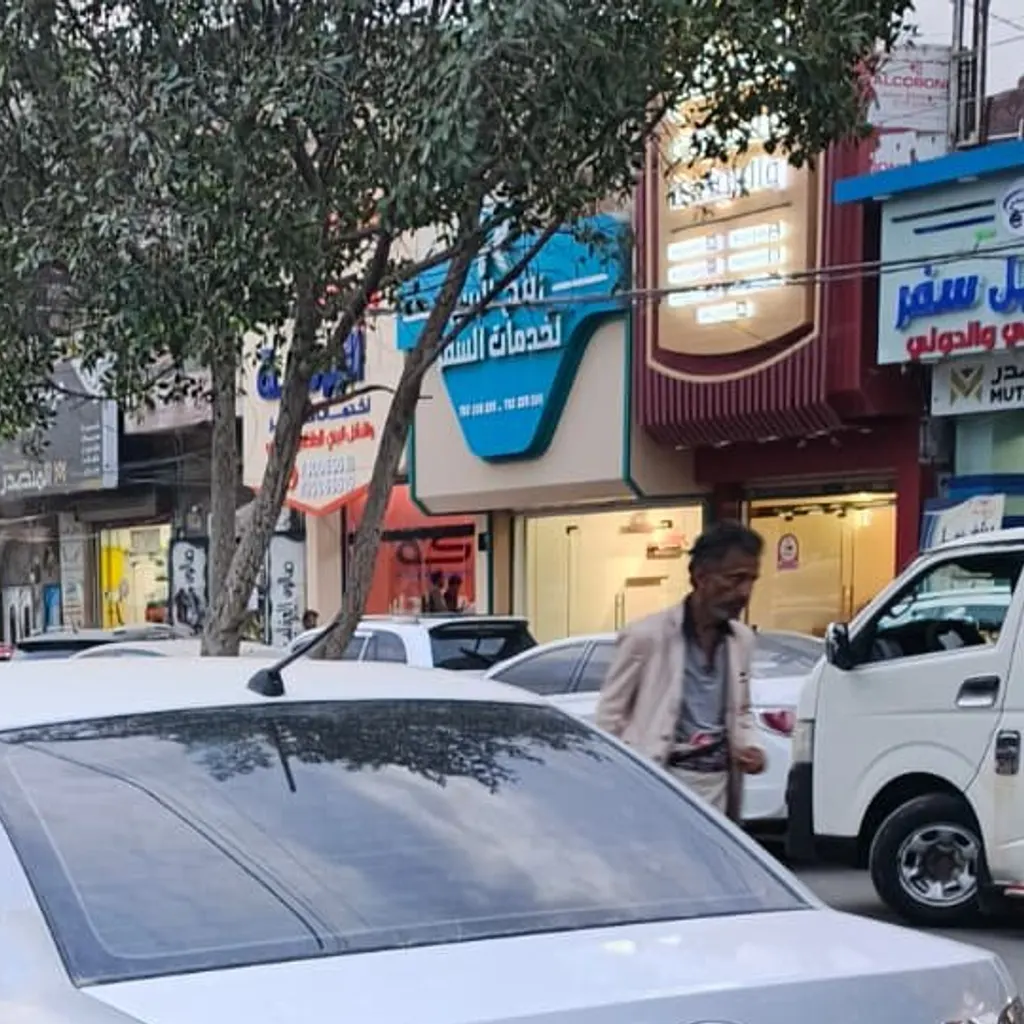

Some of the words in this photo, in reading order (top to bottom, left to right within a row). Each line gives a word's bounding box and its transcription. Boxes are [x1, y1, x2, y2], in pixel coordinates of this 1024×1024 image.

[895, 263, 979, 331] سفر
[488, 312, 562, 358] لخدمات
[906, 319, 997, 360] والدولي
